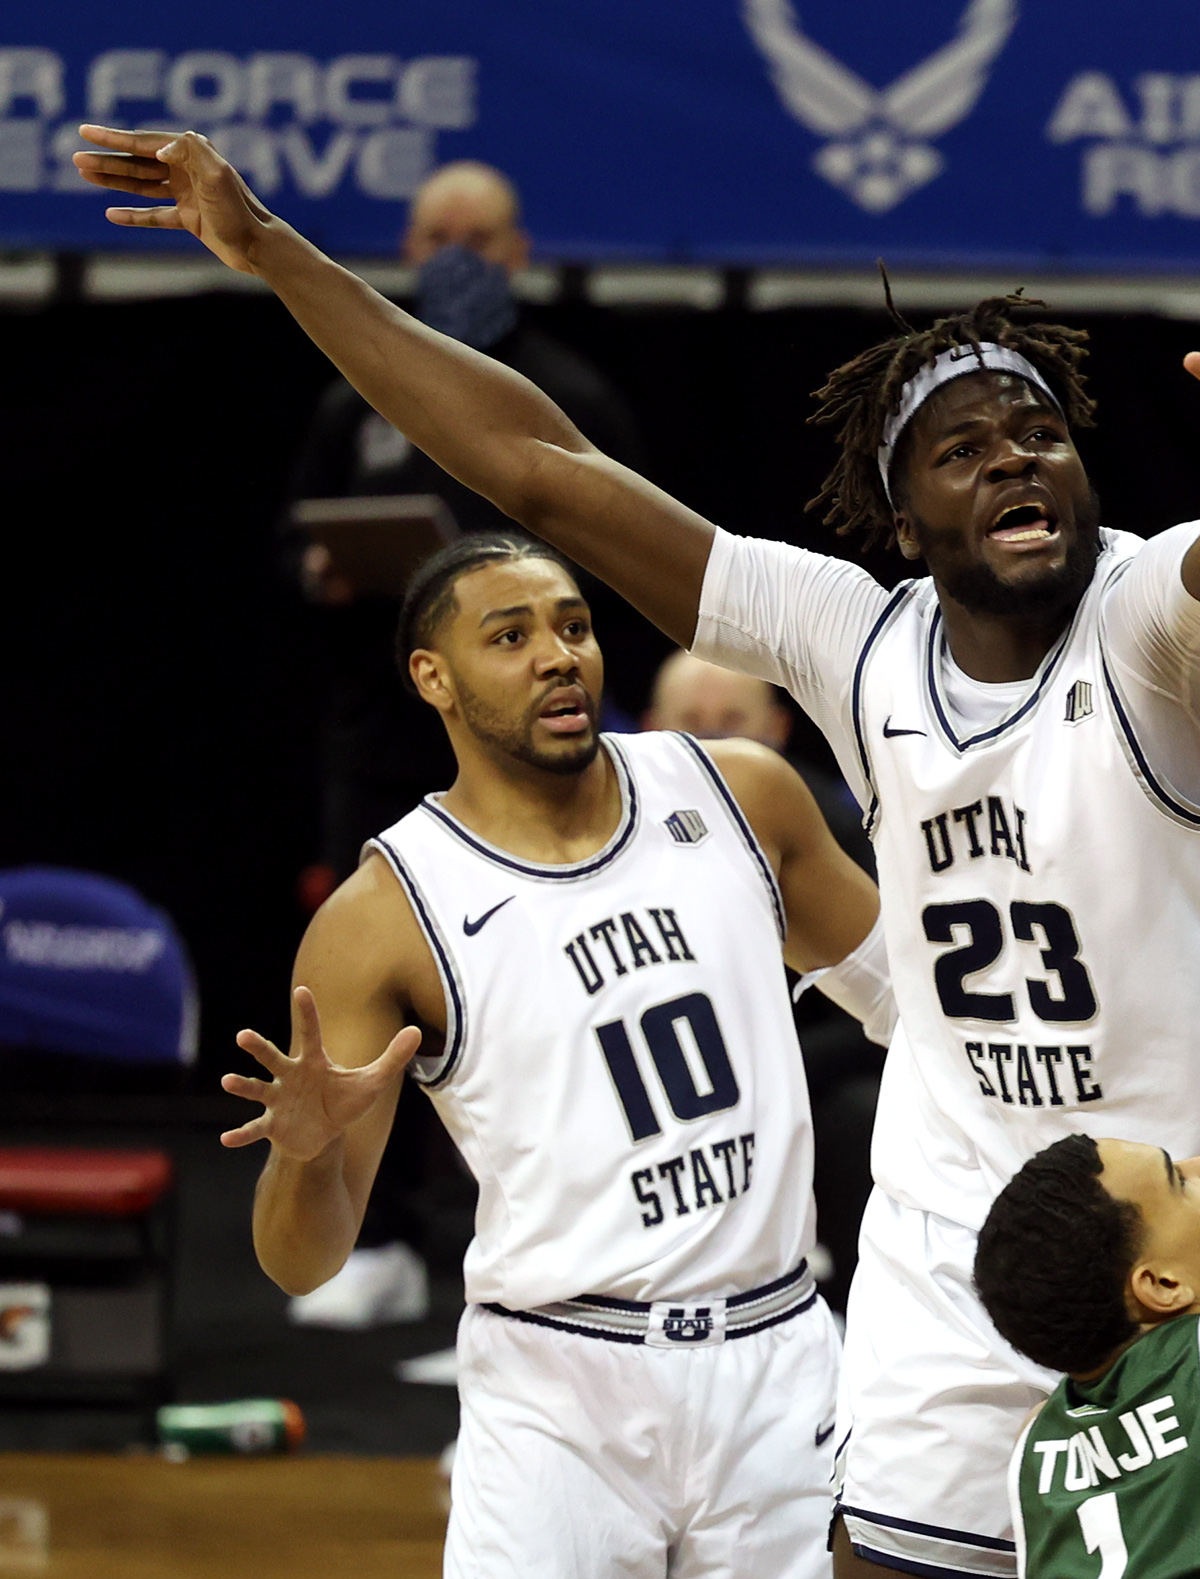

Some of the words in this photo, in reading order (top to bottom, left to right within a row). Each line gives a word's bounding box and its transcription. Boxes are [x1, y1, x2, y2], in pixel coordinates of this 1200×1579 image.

[87, 49, 480, 129] FORCE
[920, 796, 1033, 875] UTAH
[564, 906, 697, 997] UTAH
[921, 898, 1100, 1024] 23
[595, 990, 741, 1145] 10
[965, 1041, 1103, 1109] STATE
[631, 1132, 756, 1229] STATE
[1034, 1394, 1189, 1494] TONJE
[1076, 1491, 1129, 1579] 1
